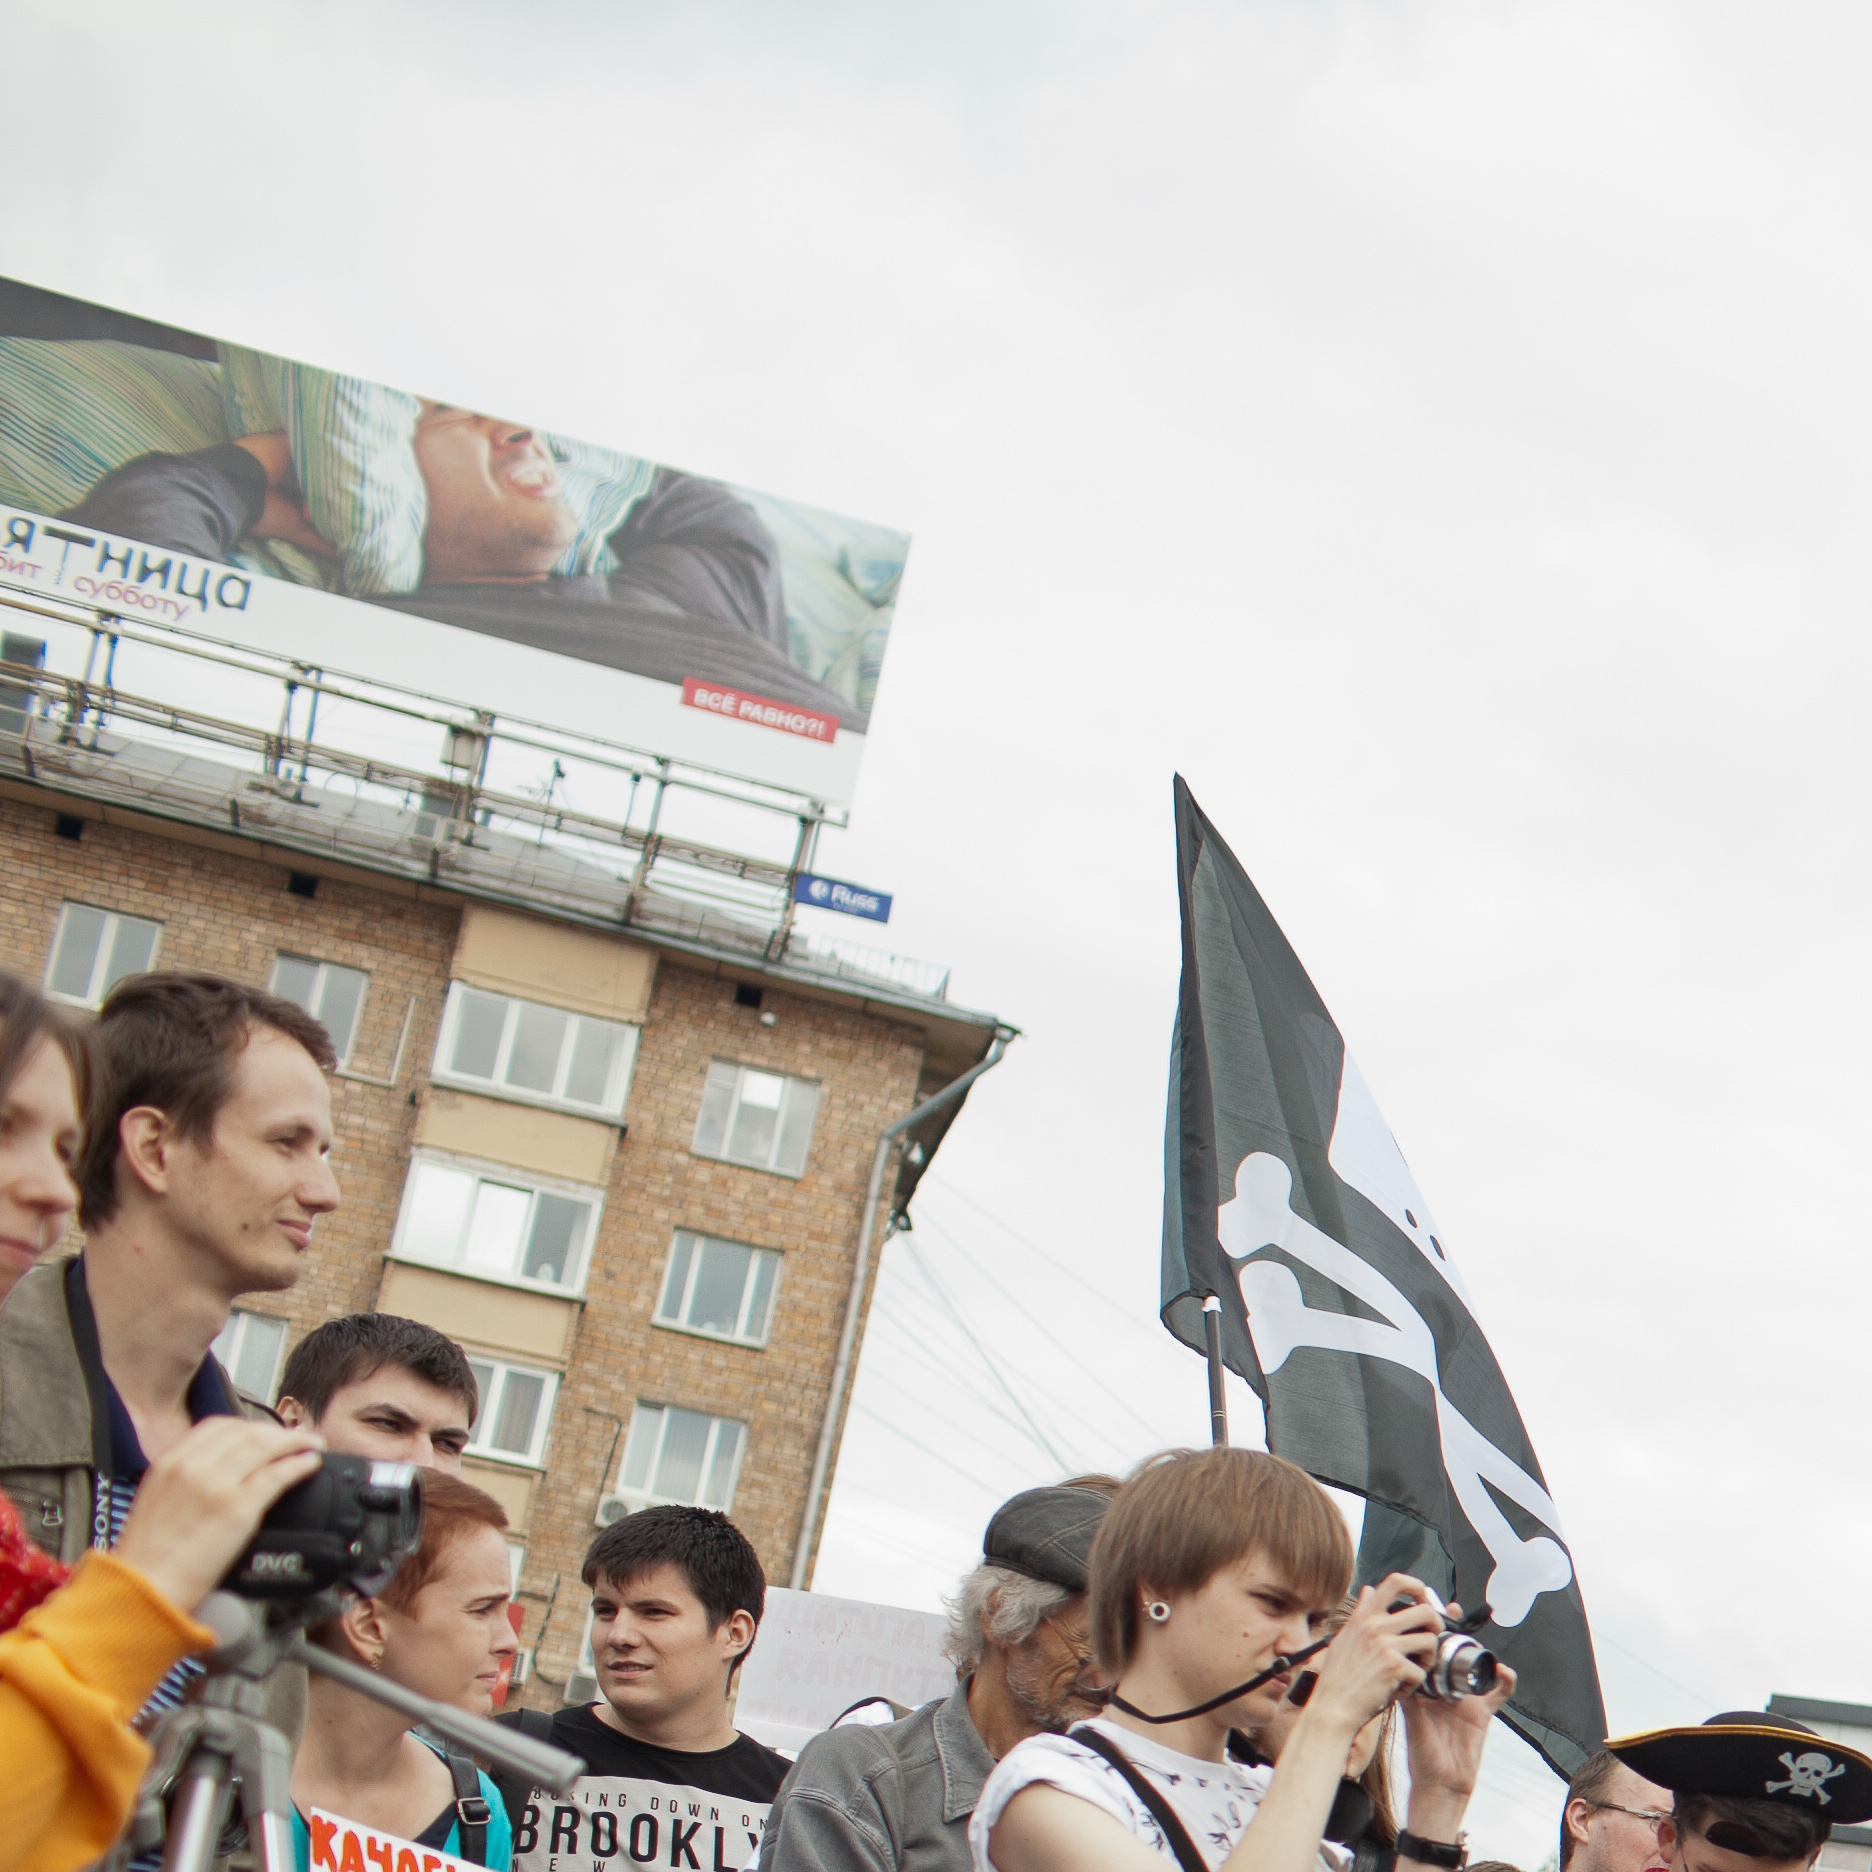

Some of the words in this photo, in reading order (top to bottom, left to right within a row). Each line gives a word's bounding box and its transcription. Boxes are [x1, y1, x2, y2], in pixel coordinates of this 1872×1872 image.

[73, 574, 190, 622] субботу
[694, 687, 736, 716] ВСЁ
[738, 698, 827, 739] РАВНО?!
[831, 884, 879, 914] Russ
[94, 1472, 111, 1554] SONY
[651, 1797, 719, 1820] DOWN
